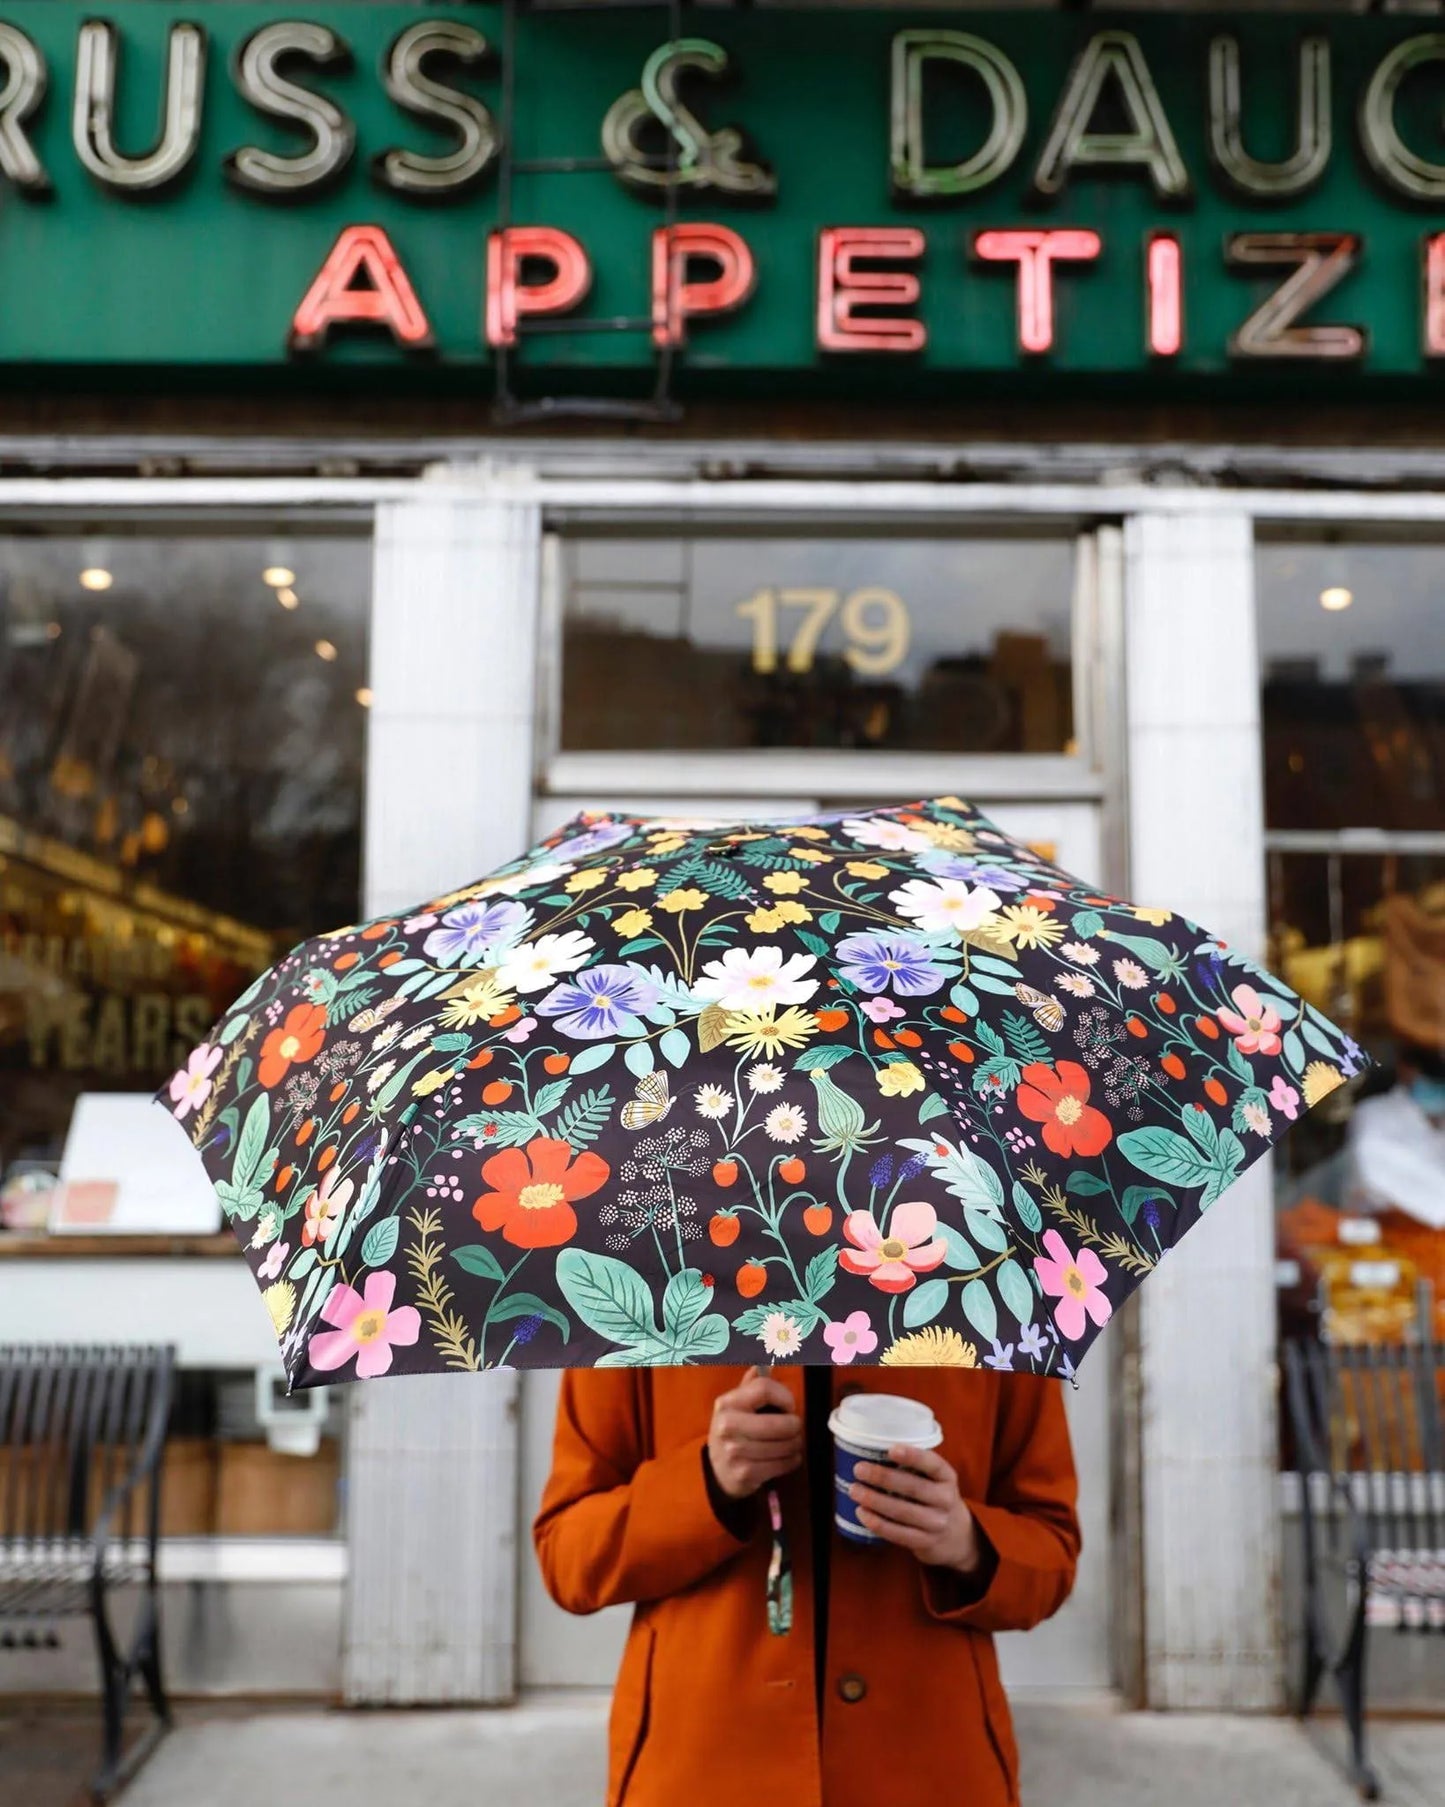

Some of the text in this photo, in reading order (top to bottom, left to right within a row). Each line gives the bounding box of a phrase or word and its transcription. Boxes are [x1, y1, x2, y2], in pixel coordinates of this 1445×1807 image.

[602, 38, 774, 195] &
[289, 222, 1445, 356] APPETIZ
[737, 587, 910, 674] 179
